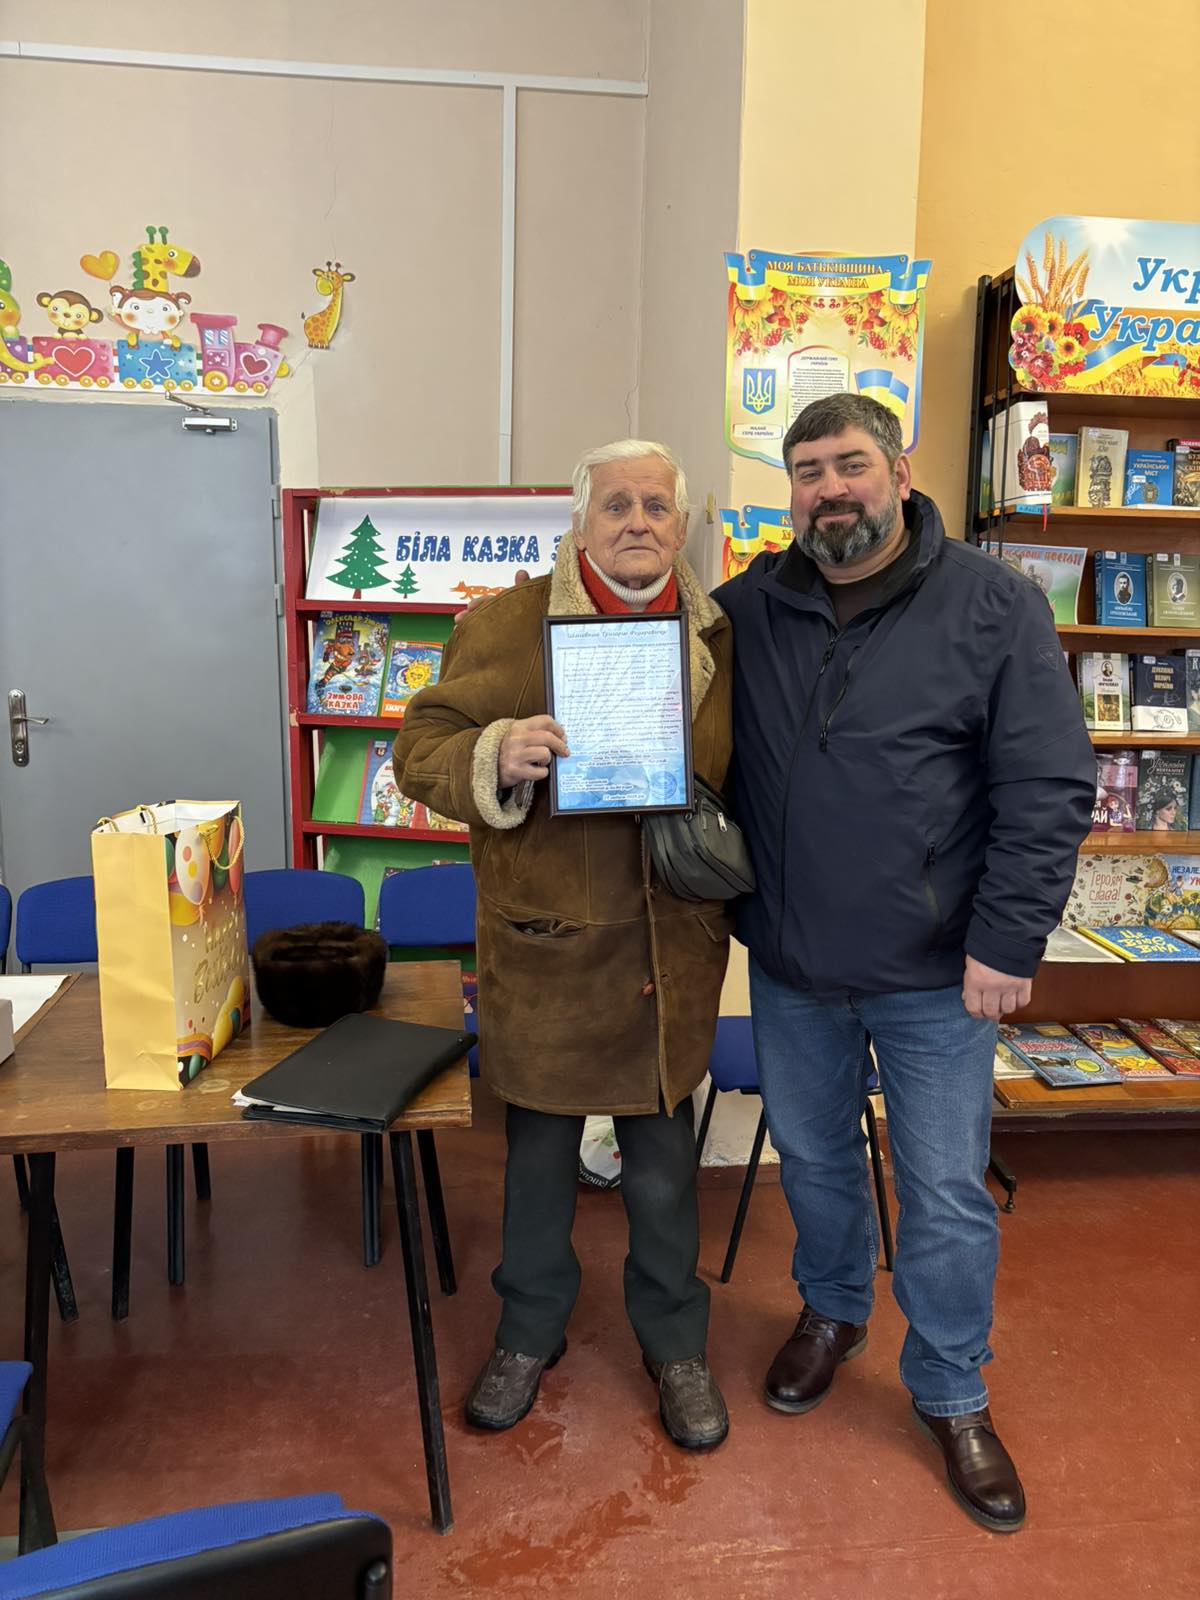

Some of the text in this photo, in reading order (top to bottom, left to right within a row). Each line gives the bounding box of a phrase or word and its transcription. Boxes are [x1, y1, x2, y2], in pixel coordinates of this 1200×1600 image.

[767, 261, 883, 274] МОЯ БАТЬКІВЩИНА
[787, 275, 869, 288] МОЯ УКРАЇНА
[395, 531, 451, 562] БІЛА
[461, 535, 540, 563] КАЗКА
[327, 692, 364, 701] ЗИМОВА
[328, 701, 359, 709] КАЗКА
[1091, 870, 1124, 890] Героям
